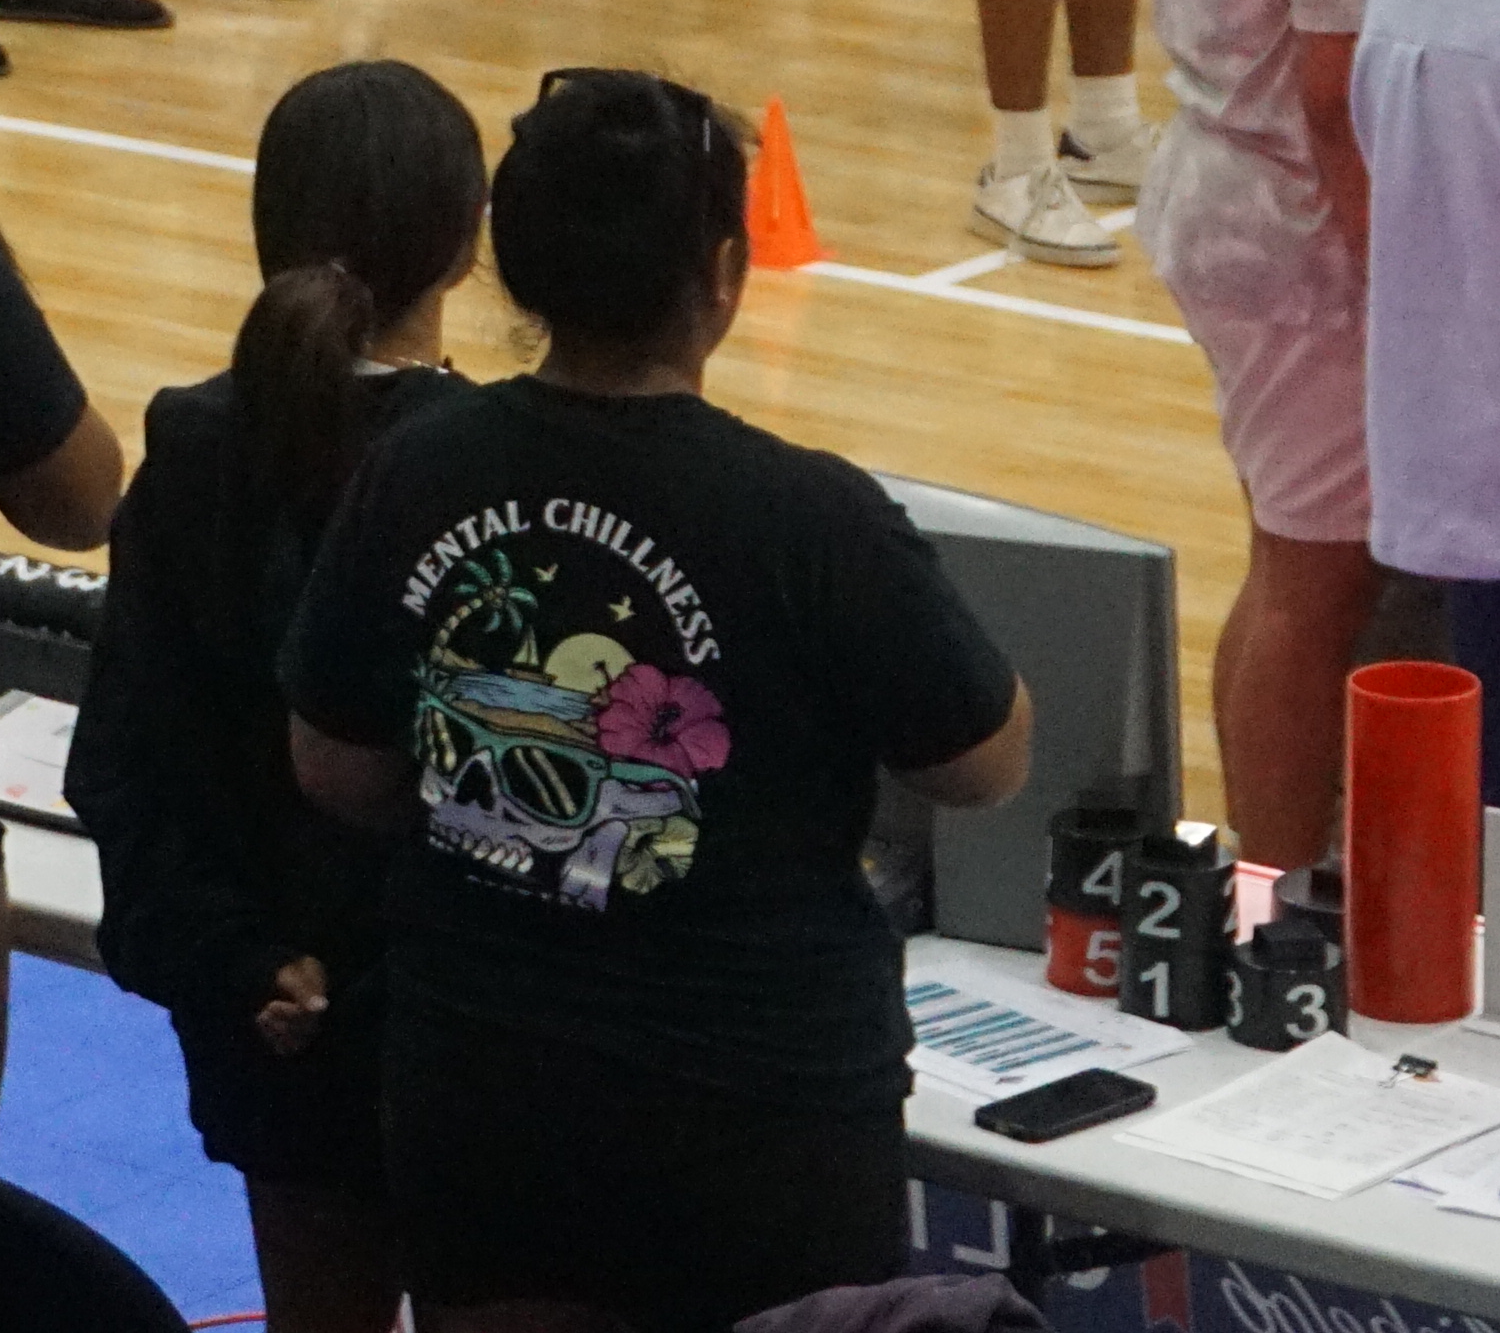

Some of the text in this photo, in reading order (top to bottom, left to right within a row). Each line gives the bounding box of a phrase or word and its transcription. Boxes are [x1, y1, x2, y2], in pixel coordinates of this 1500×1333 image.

[401, 497, 721, 666] MENTAL CHILLNESS
[1081, 850, 1123, 906] 4
[1136, 881, 1182, 939] 2
[1082, 930, 1123, 987] 5
[1139, 961, 1170, 1018] 1
[1285, 984, 1329, 1039] 3
